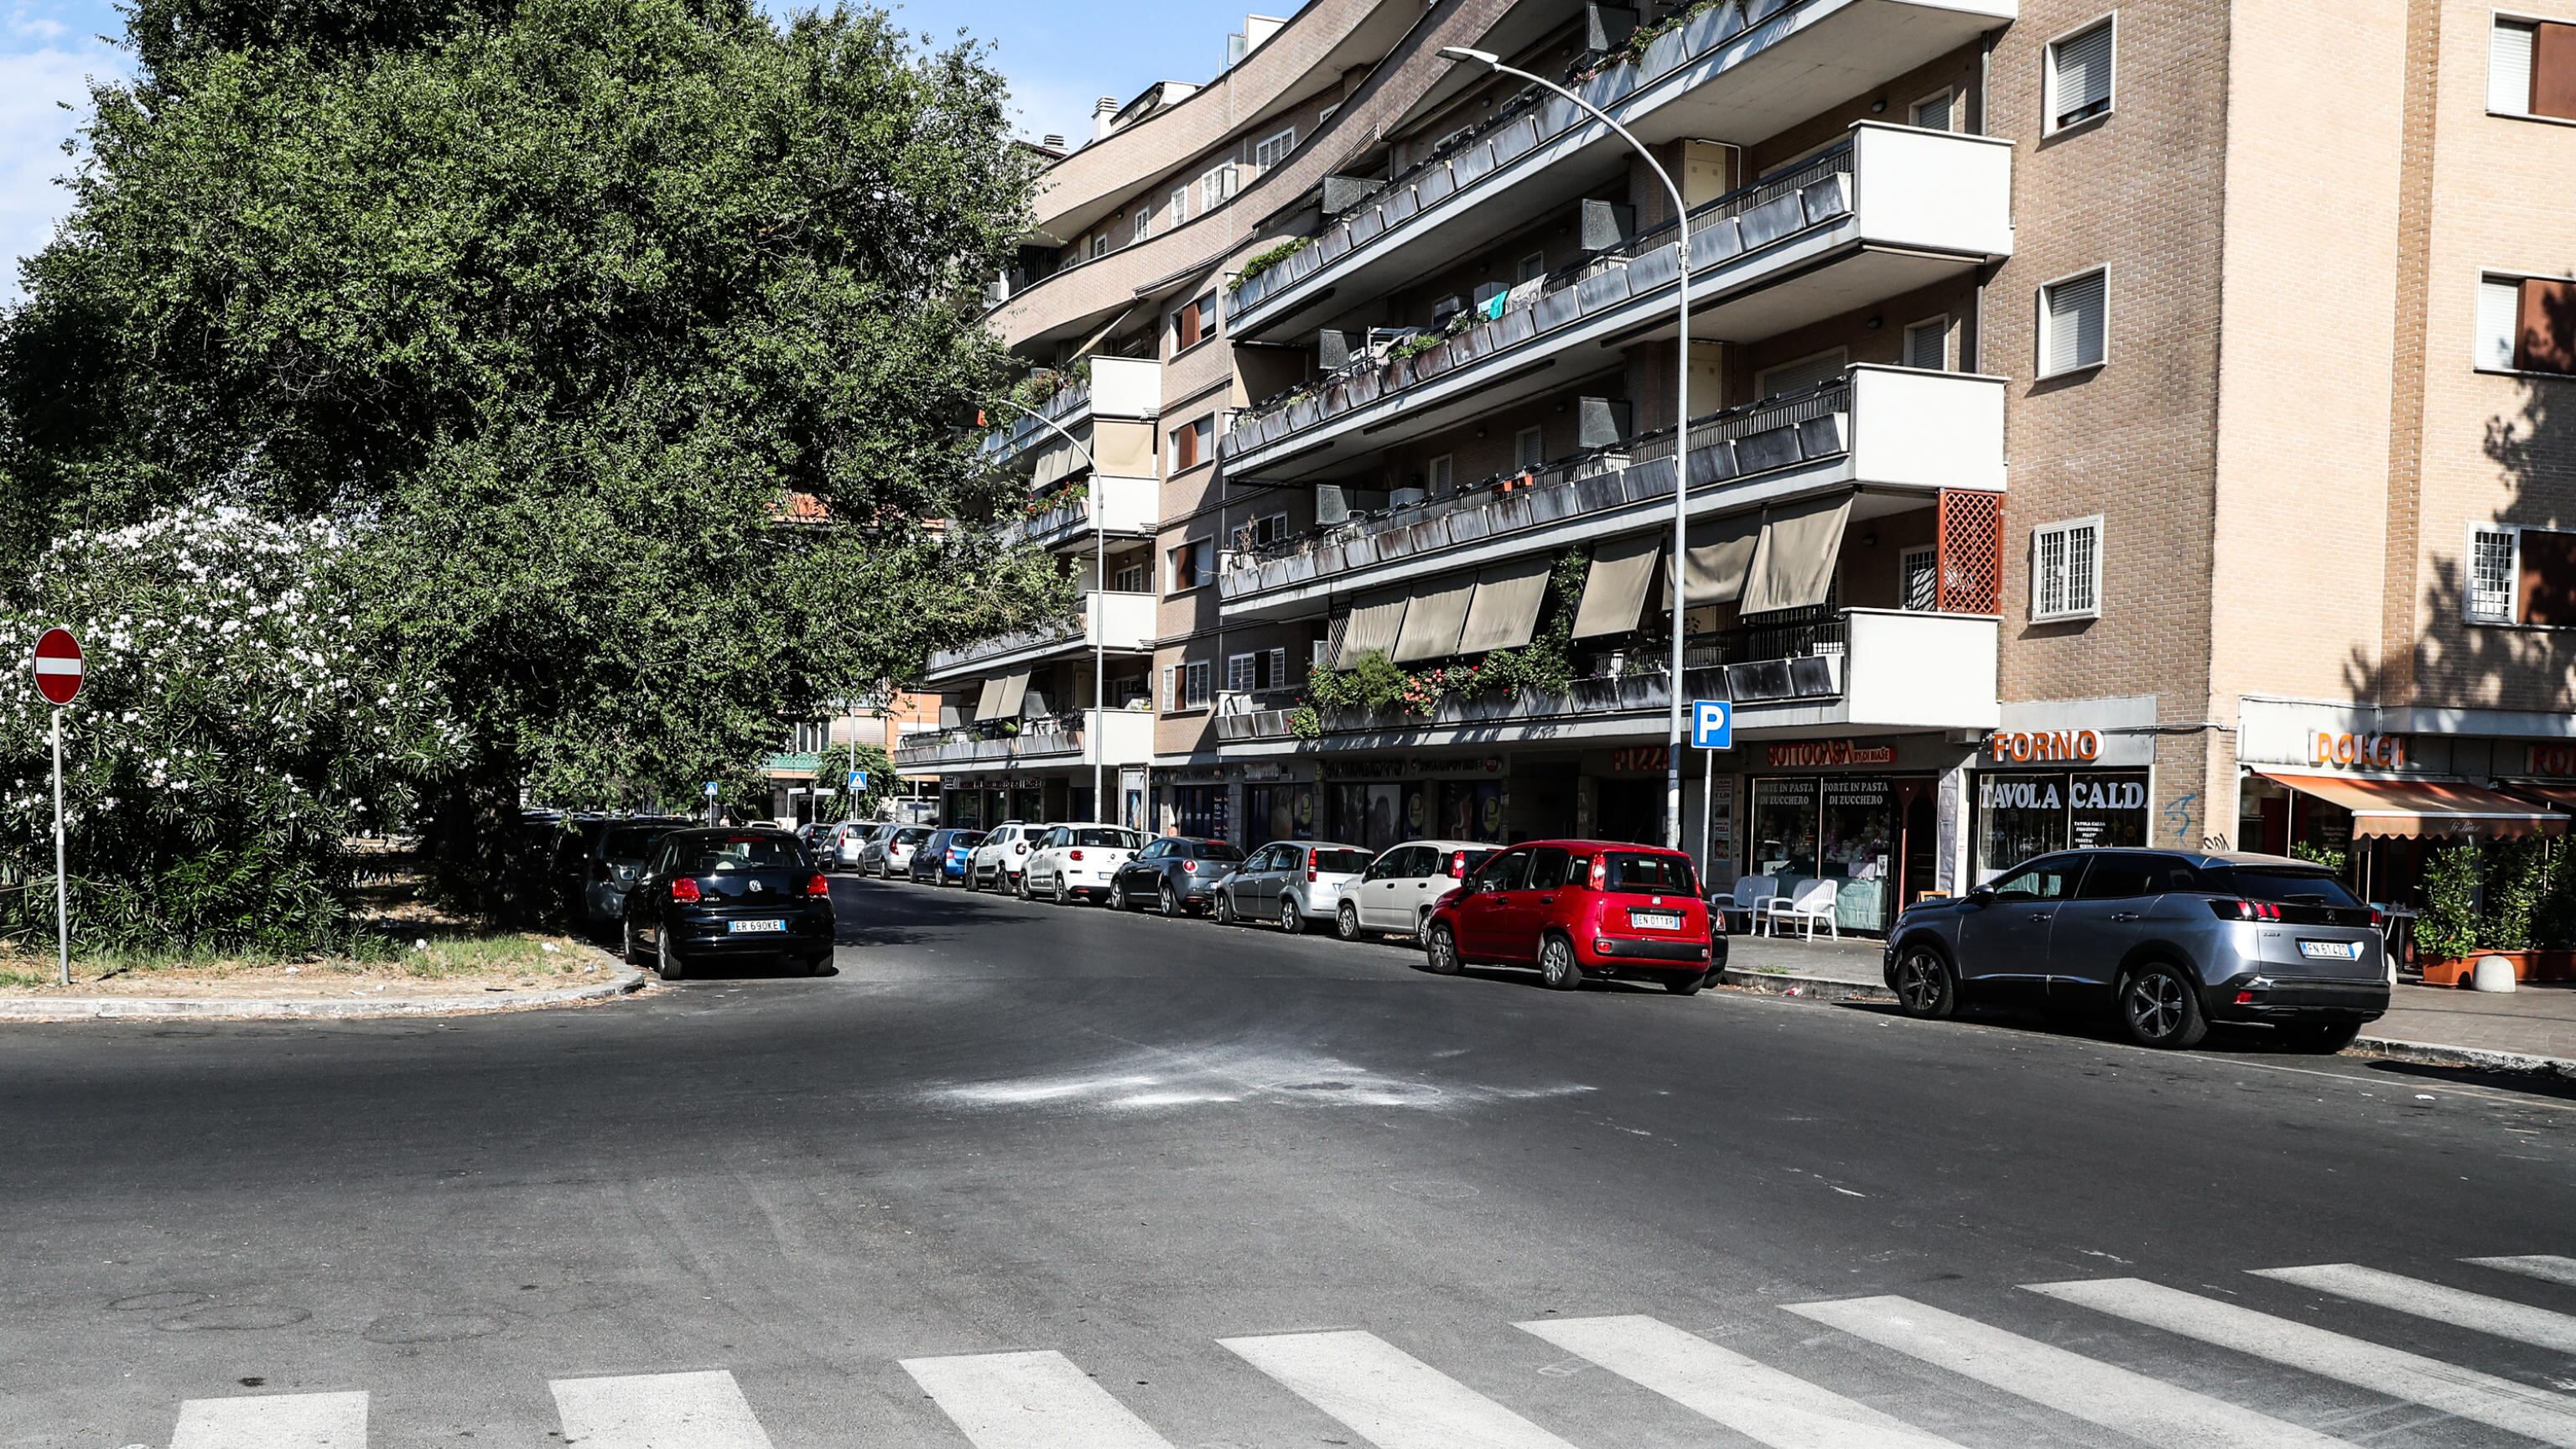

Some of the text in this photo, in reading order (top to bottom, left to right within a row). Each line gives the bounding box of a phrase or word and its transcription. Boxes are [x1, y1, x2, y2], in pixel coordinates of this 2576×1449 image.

[1700, 705, 1725, 744] P
[1767, 740, 1854, 766] SOTTOCASA
[1993, 730, 2104, 761] FORNO
[2313, 732, 2404, 766] DOLCI
[1613, 746, 1670, 771] PIZZA
[2529, 745, 2576, 774] FO
[1779, 784, 1788, 792] IN
[1789, 783, 1815, 792] PASTA
[1824, 782, 1888, 792] TORTE IN PASTA
[1980, 782, 2148, 809] TAVOLA CALD
[1769, 796, 1810, 805] ZUCCHERO
[1829, 796, 1883, 805] DI ZUCCHERO
[735, 921, 779, 931] ER 690KE
[1639, 915, 1648, 925] EN
[2307, 943, 2319, 954] FN
